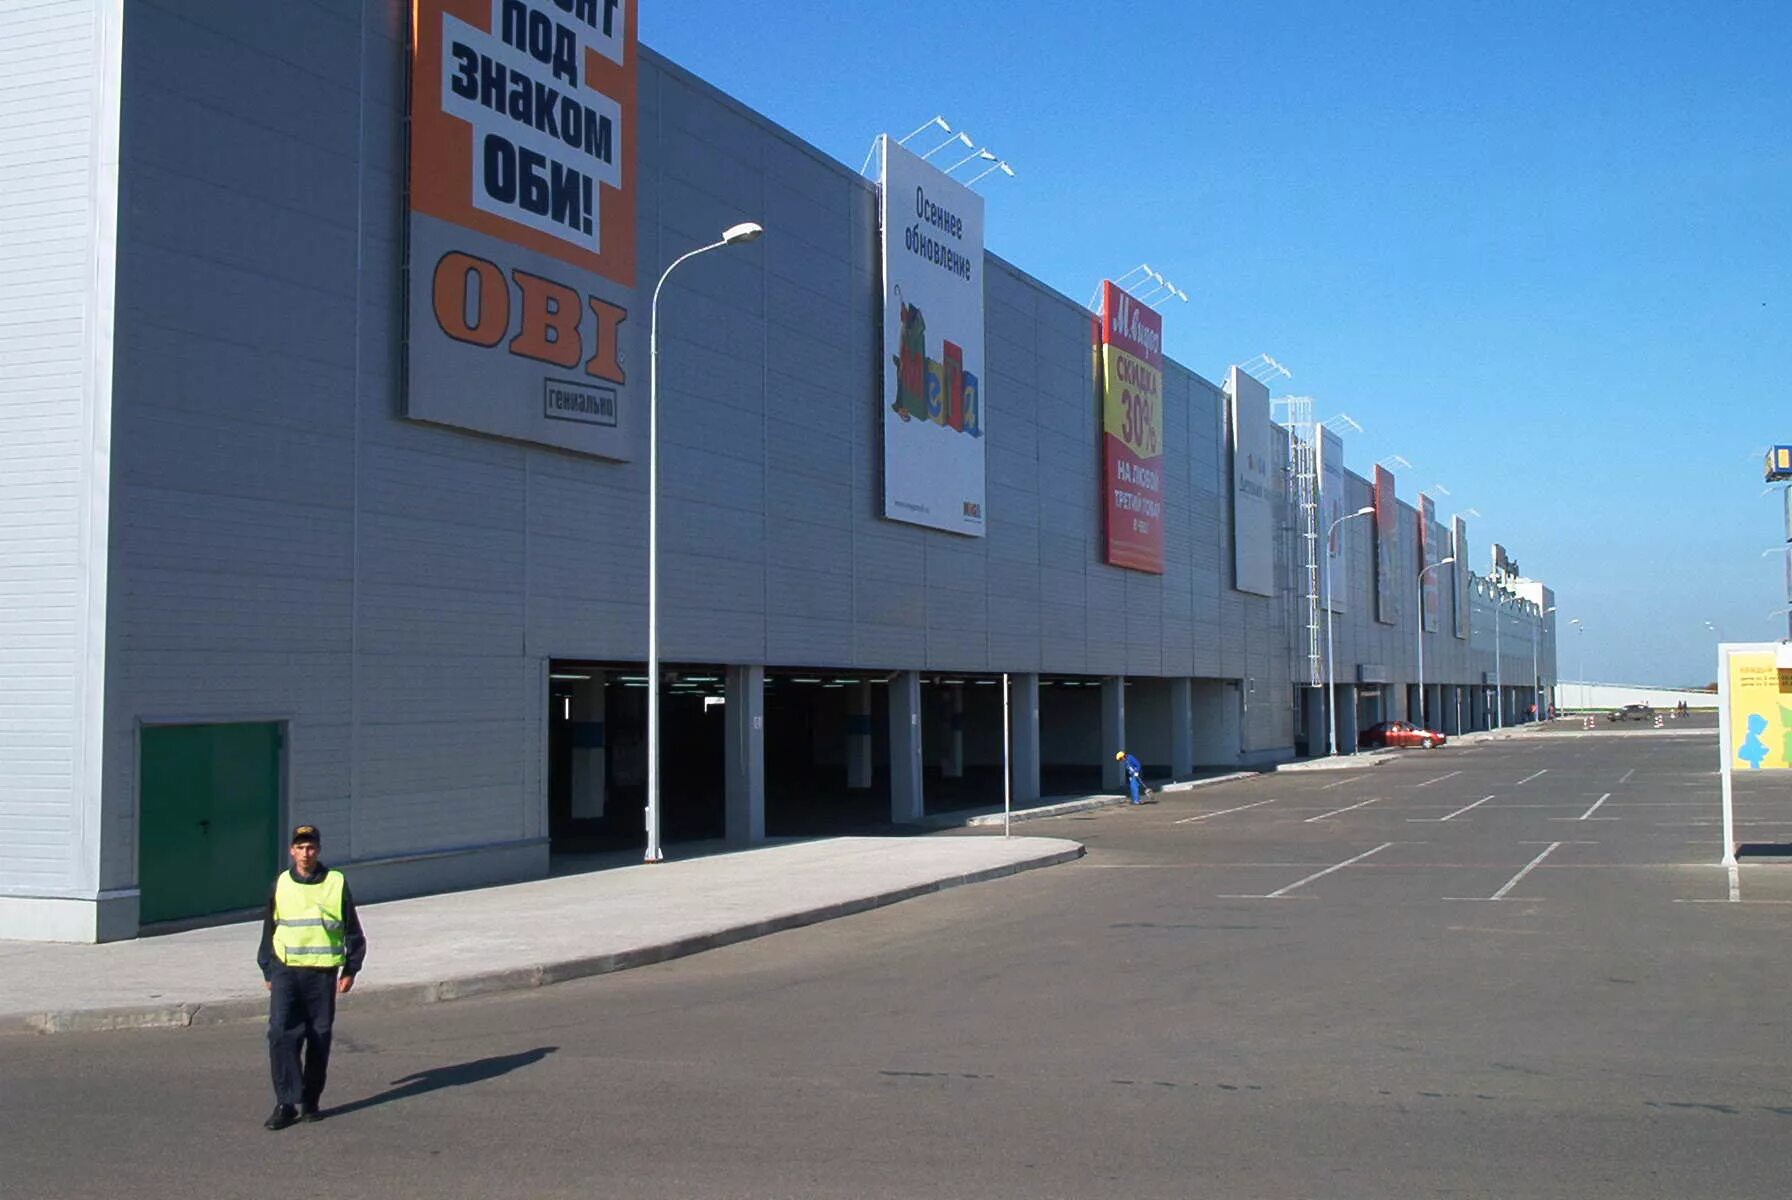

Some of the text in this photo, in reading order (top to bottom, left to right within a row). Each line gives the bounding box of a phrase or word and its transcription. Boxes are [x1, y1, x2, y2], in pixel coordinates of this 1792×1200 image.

[501, 0, 578, 90] ПОД
[483, 133, 594, 237] ОБИ!
[916, 186, 963, 241] Осеннее
[905, 223, 971, 282] обновление
[432, 250, 628, 385] OBI
[548, 389, 614, 417] гениально
[1121, 387, 1158, 455] 30%
